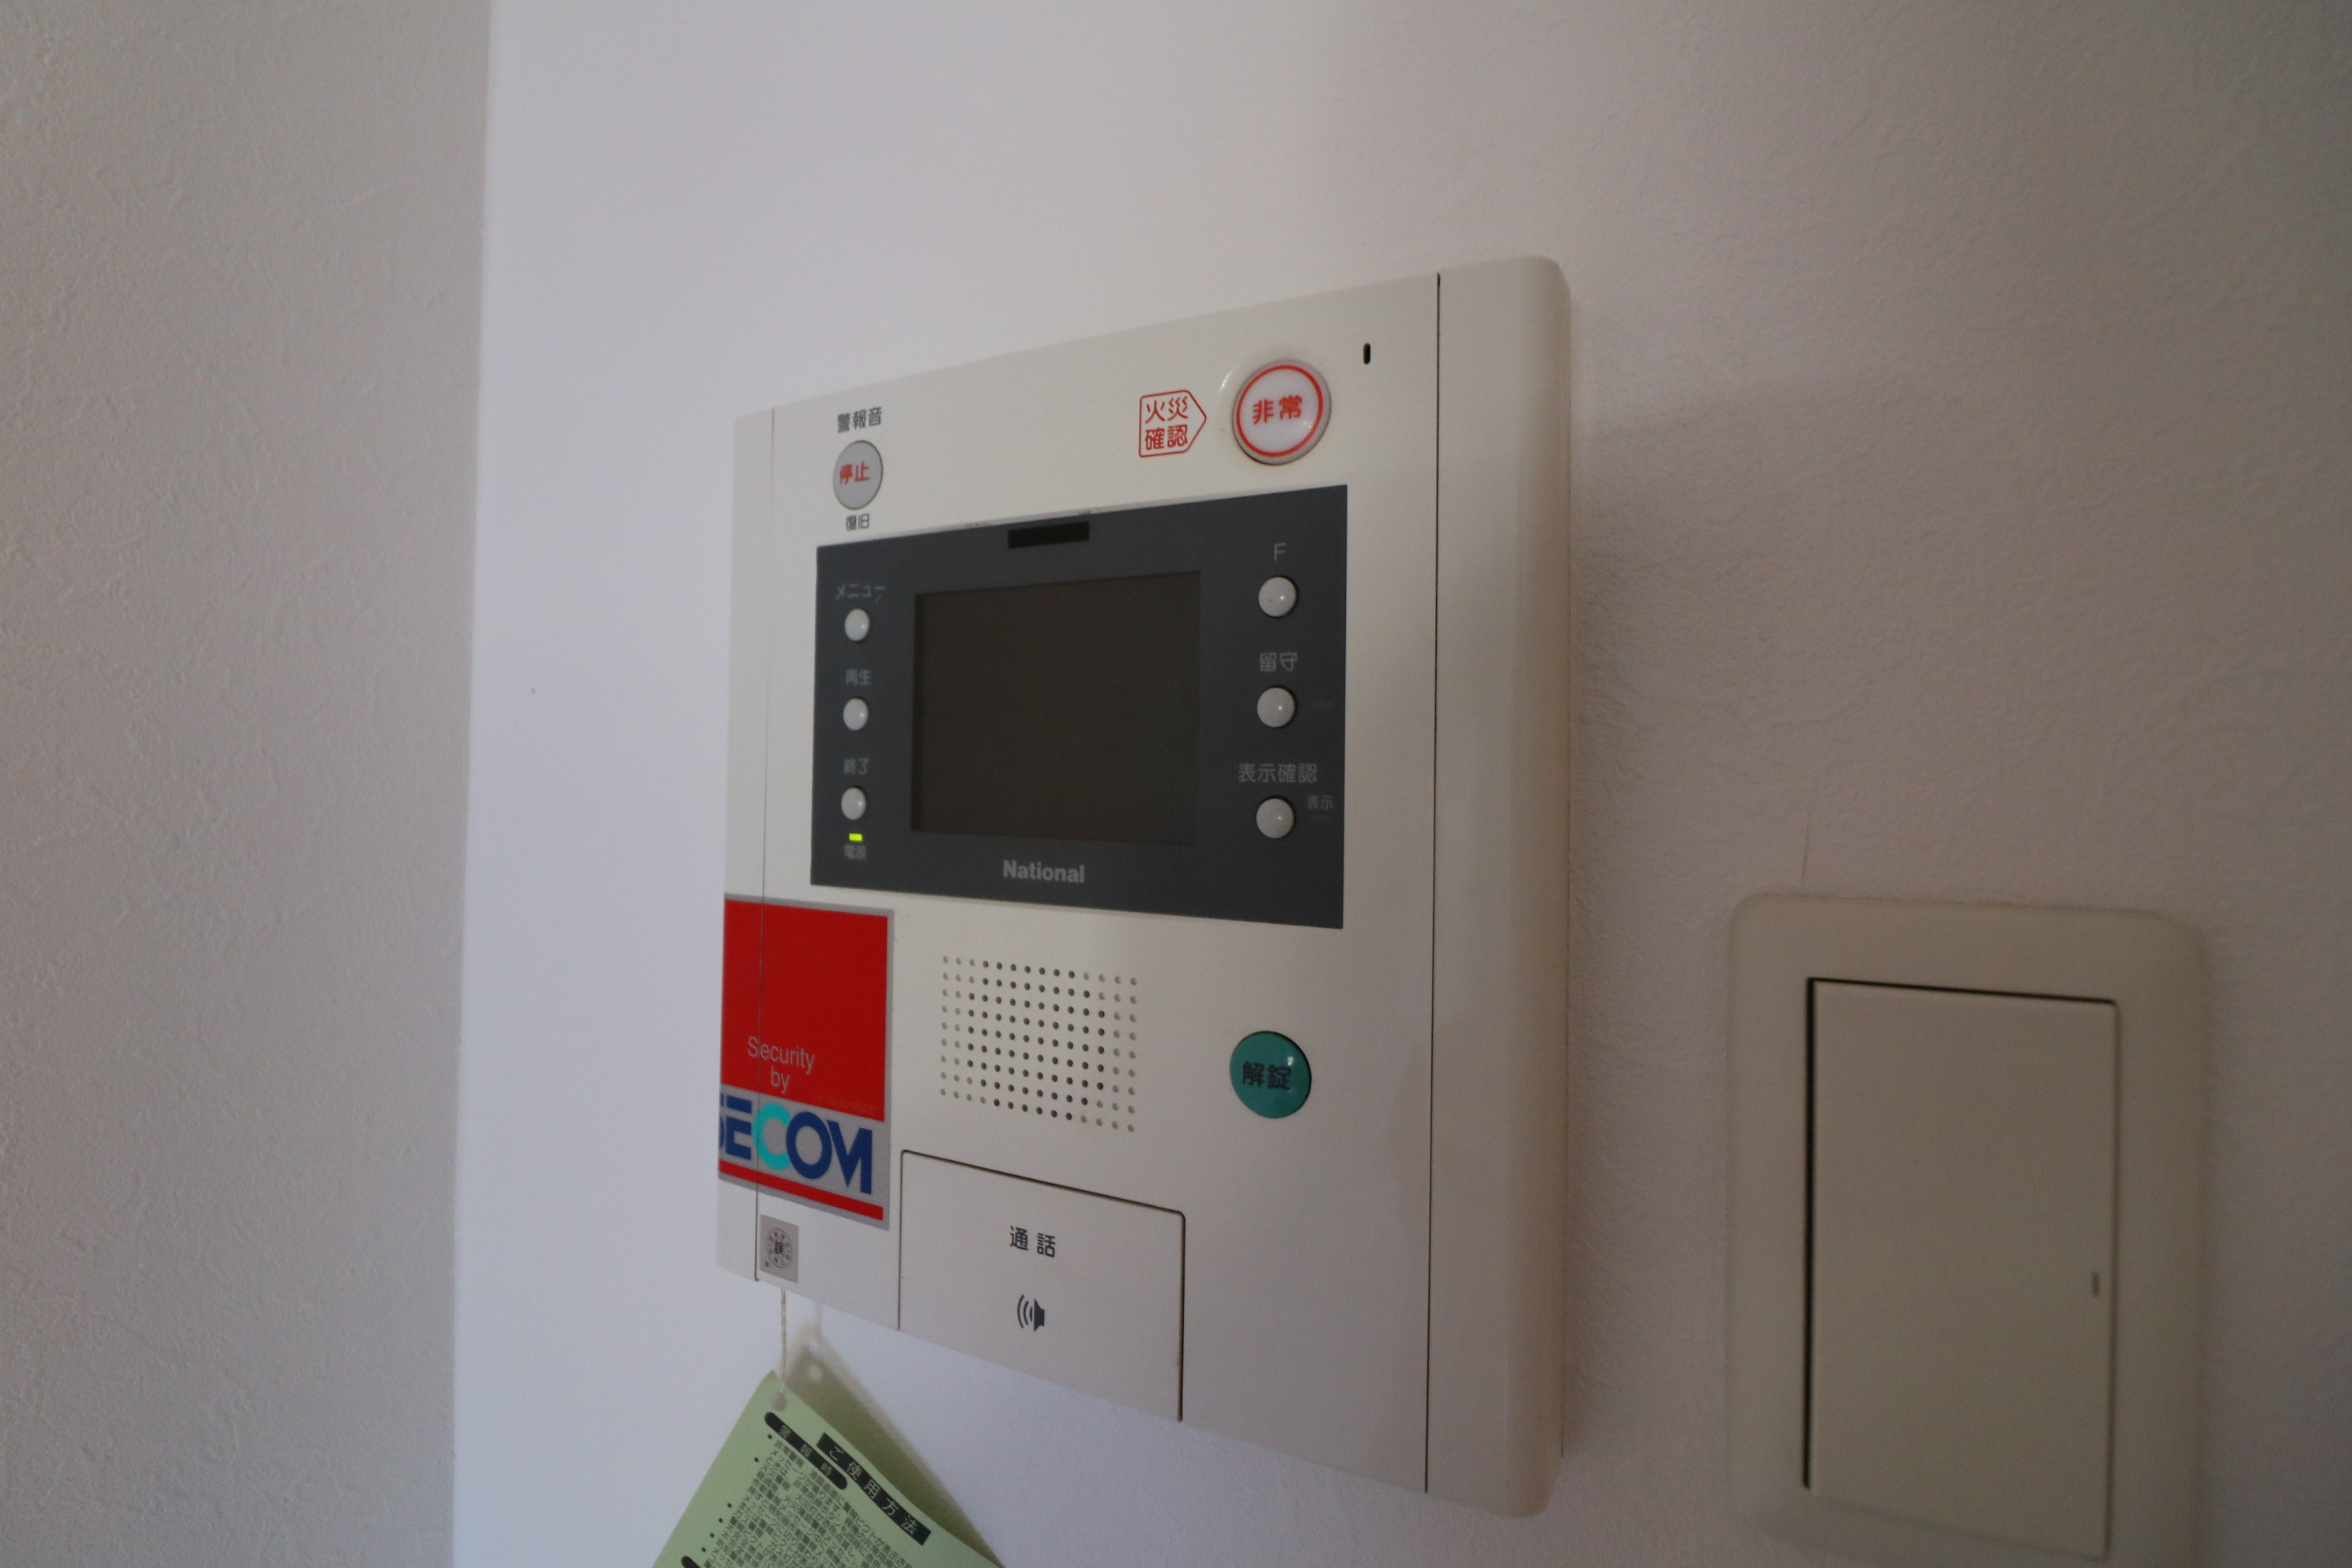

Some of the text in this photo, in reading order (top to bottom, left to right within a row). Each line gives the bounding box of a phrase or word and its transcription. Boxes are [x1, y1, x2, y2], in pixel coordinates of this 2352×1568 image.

[837, 406, 883, 433] 警報音
[1145, 396, 1188, 424] 火災
[1252, 394, 1303, 425] 非常
[1144, 424, 1188, 450] 確認
[839, 462, 870, 484] 停止
[1273, 543, 1287, 562] F
[1259, 651, 1298, 672] 留守
[845, 669, 872, 686] 再生
[843, 758, 869, 775] 終了
[1238, 763, 1317, 784] 表示確認
[1306, 795, 1334, 811] 表示
[1002, 859, 1085, 884] National
[747, 1036, 816, 1074] Security
[770, 1067, 790, 1094] by
[1242, 1061, 1291, 1090] 解錠
[719, 1092, 873, 1195] ECOM
[1009, 1225, 1056, 1258] 通話
[827, 1445, 920, 1536] ご使用方法
